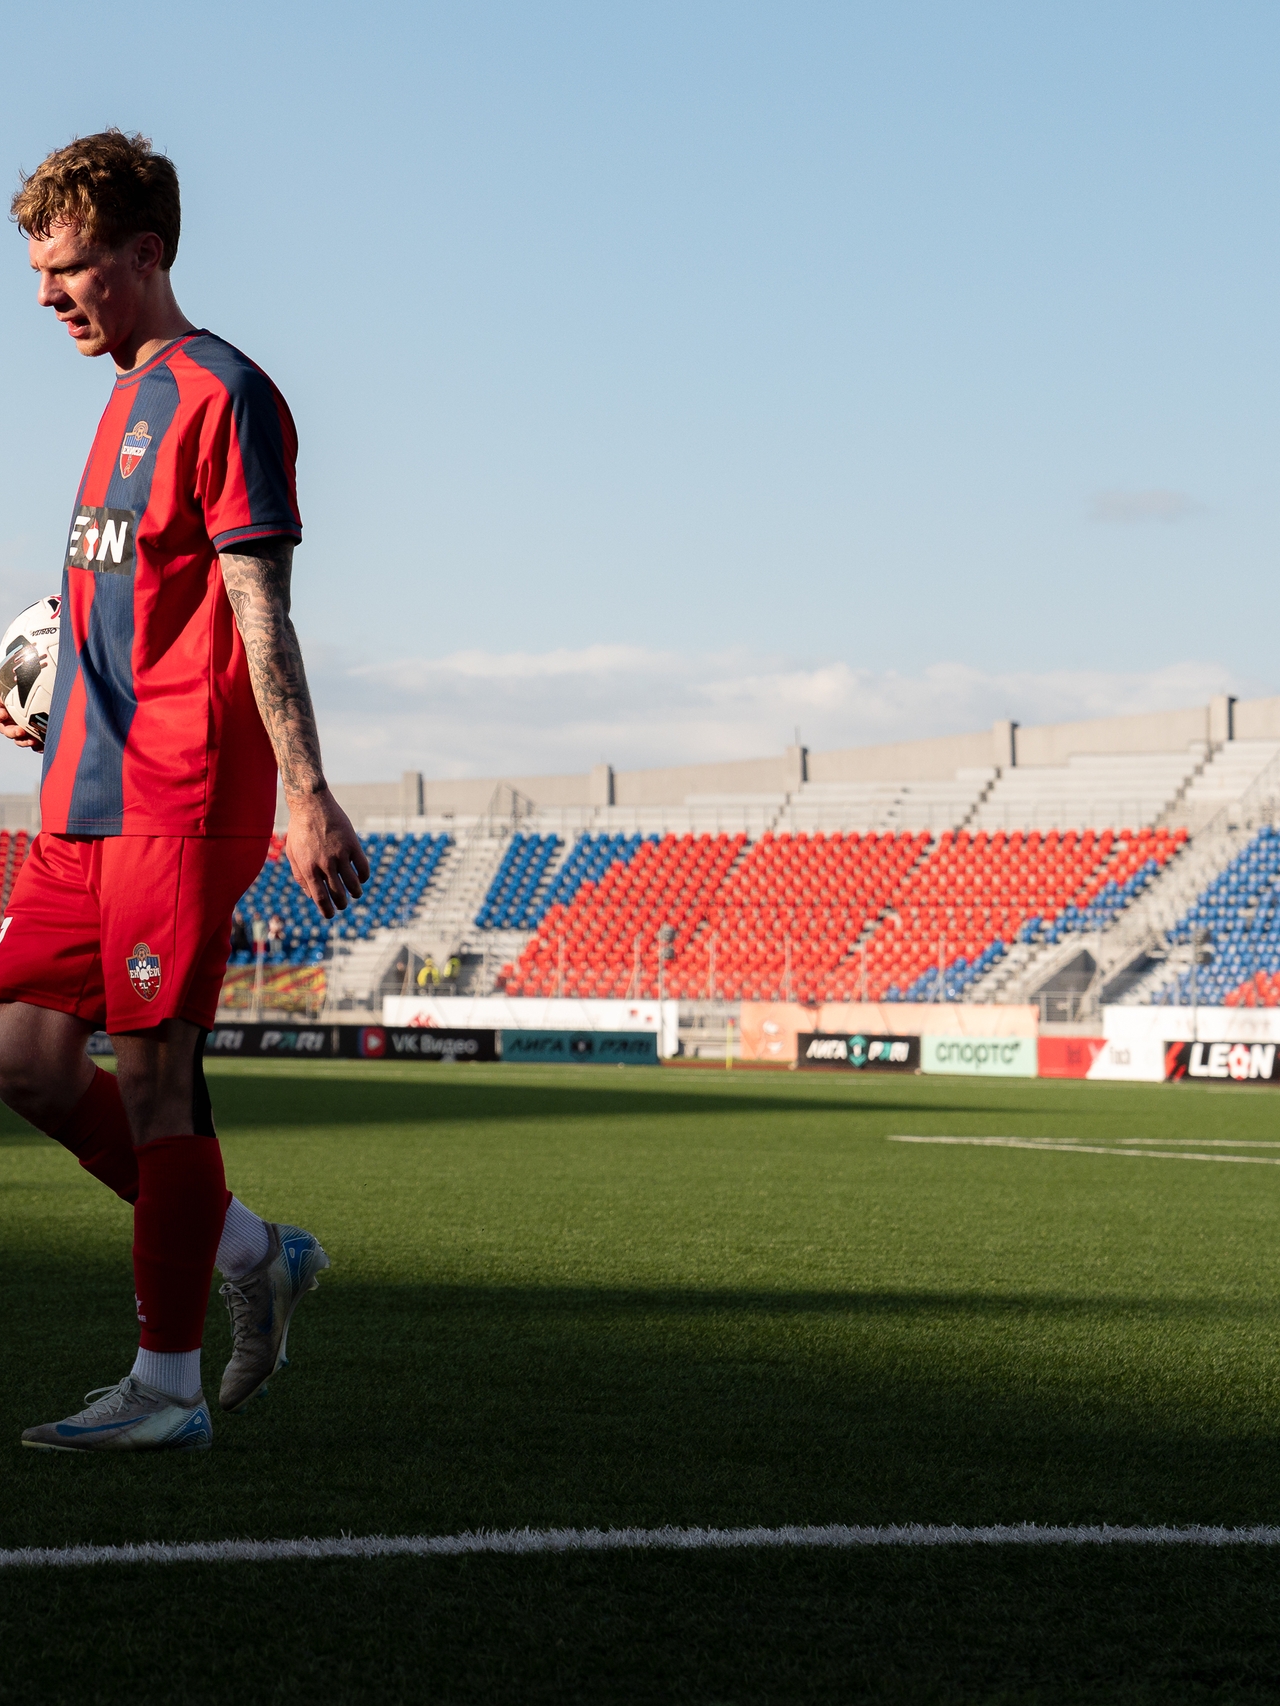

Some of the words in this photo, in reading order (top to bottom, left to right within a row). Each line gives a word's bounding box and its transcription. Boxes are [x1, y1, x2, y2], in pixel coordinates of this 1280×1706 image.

[69, 516, 128, 563] EON
[260, 1030, 325, 1050] PARI
[391, 1034, 420, 1051] VK
[420, 1034, 479, 1055] Видео
[806, 1039, 847, 1059] ЛИГА
[868, 1041, 909, 1062] PARI
[1188, 1042, 1276, 1080] LEON
